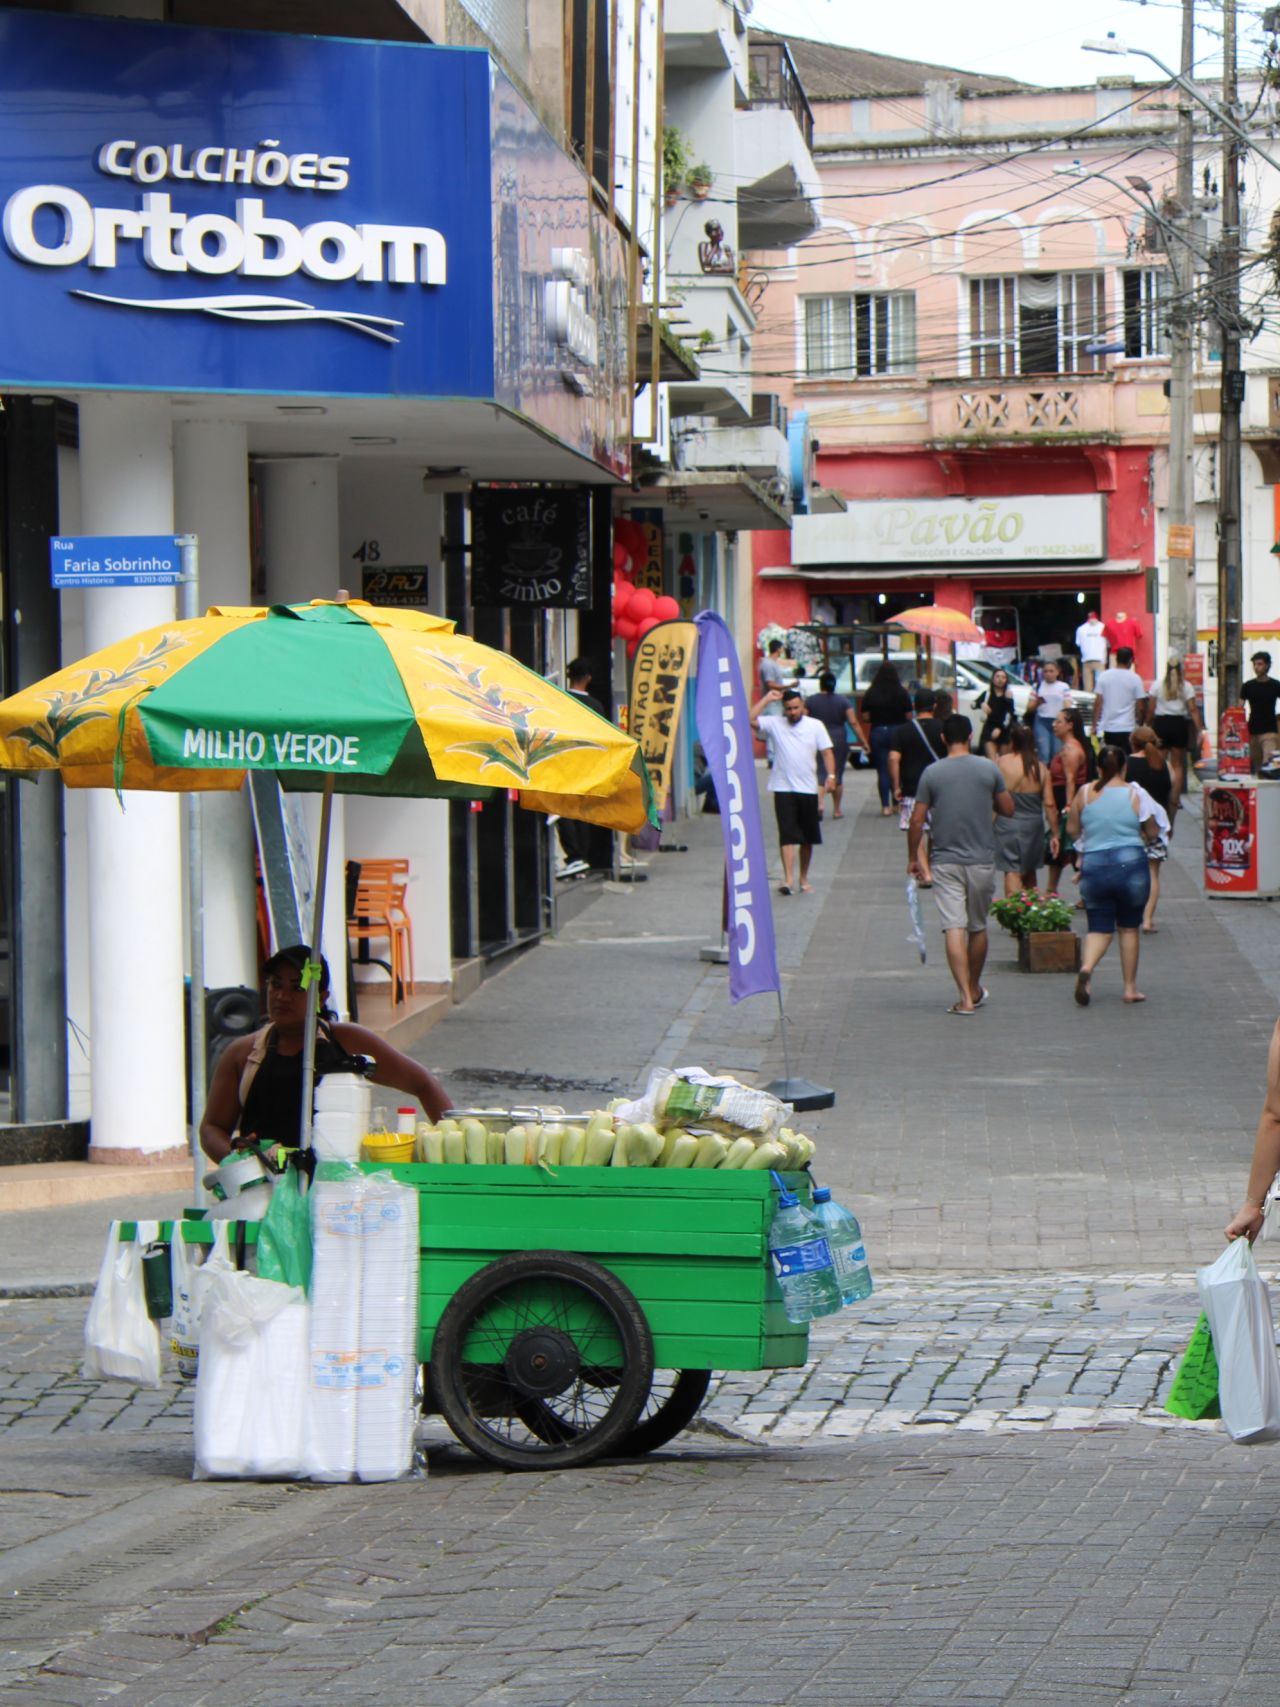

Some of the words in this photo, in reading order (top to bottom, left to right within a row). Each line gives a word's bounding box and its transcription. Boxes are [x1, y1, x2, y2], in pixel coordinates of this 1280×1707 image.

[99, 139, 350, 190] COLCHÕES
[3, 184, 447, 285] Ortobom
[501, 499, 560, 525] café
[875, 502, 1024, 546] Pavão
[54, 541, 74, 550] Rua
[64, 559, 100, 572] Faria
[105, 557, 171, 572] Sobrinho
[55, 577, 80, 585] Centro
[82, 576, 114, 584] Histórico
[499, 578, 562, 602] zinho
[640, 642, 656, 674] DO
[184, 729, 266, 761] MILHO
[273, 731, 359, 766] VERDE
[1221, 839, 1245, 855] 10X
